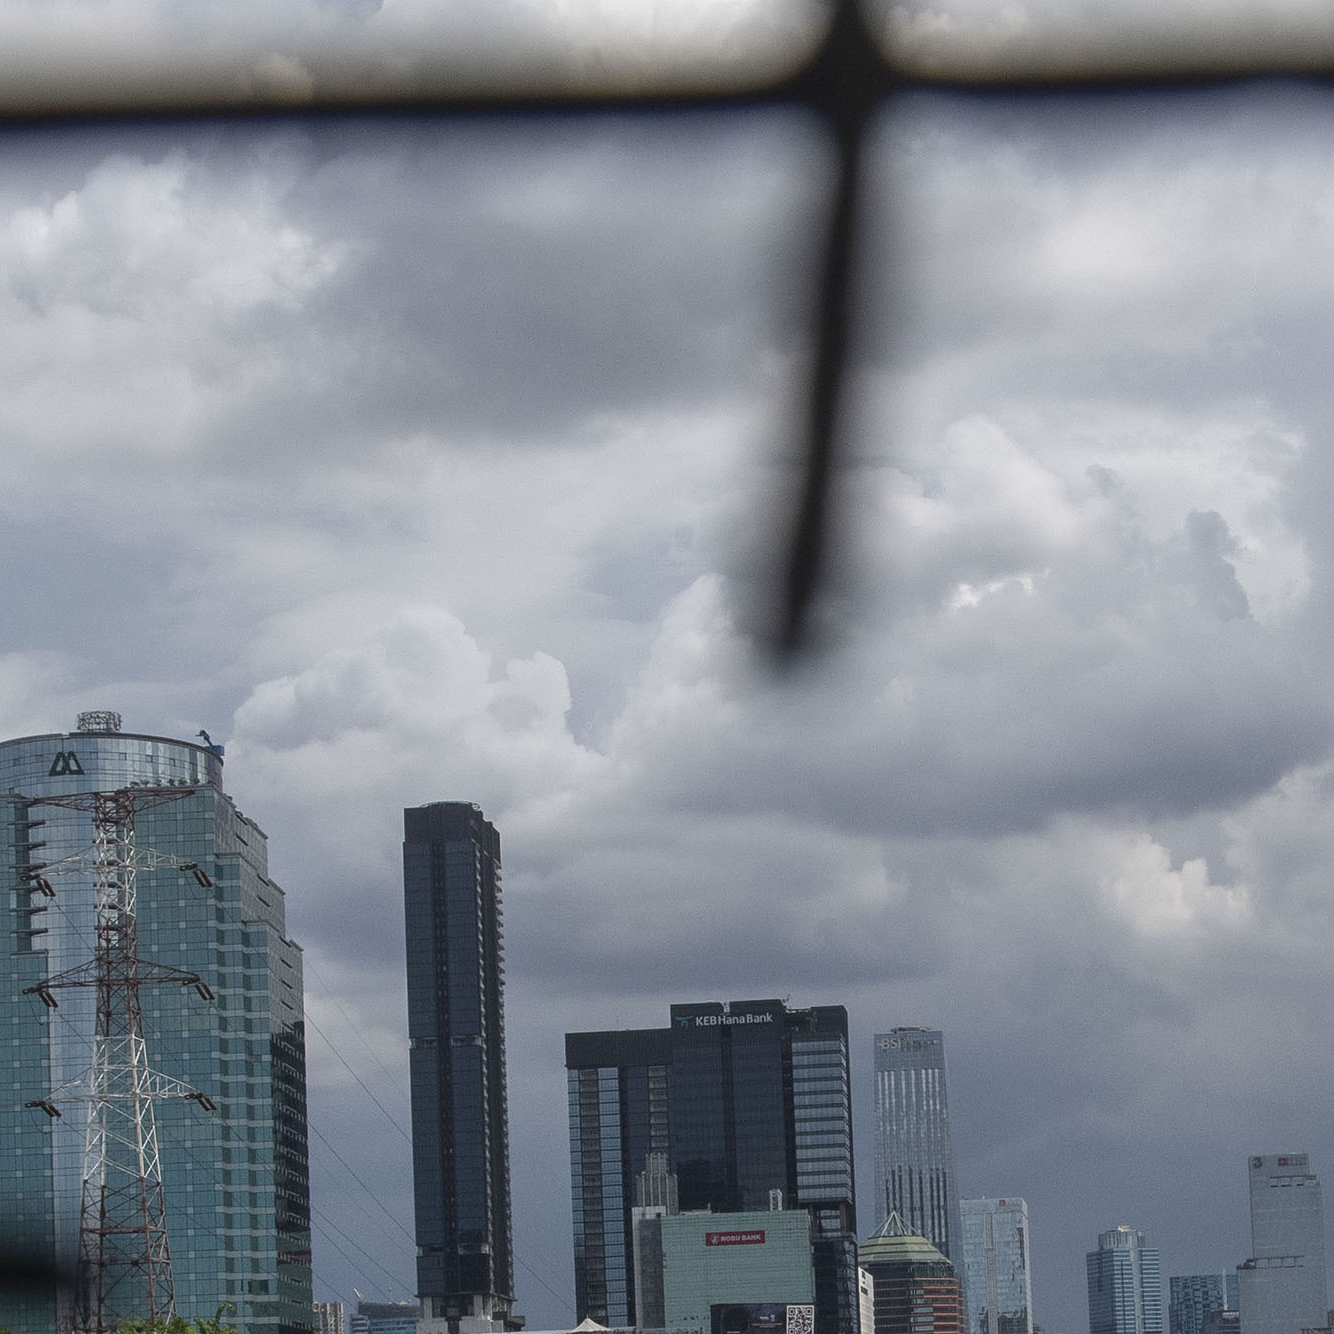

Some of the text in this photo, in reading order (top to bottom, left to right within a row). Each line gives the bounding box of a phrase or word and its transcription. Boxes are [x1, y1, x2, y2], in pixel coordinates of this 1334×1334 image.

[695, 1011, 773, 1026] KEB Hana Bank
[720, 1234, 740, 1242] NOBU
